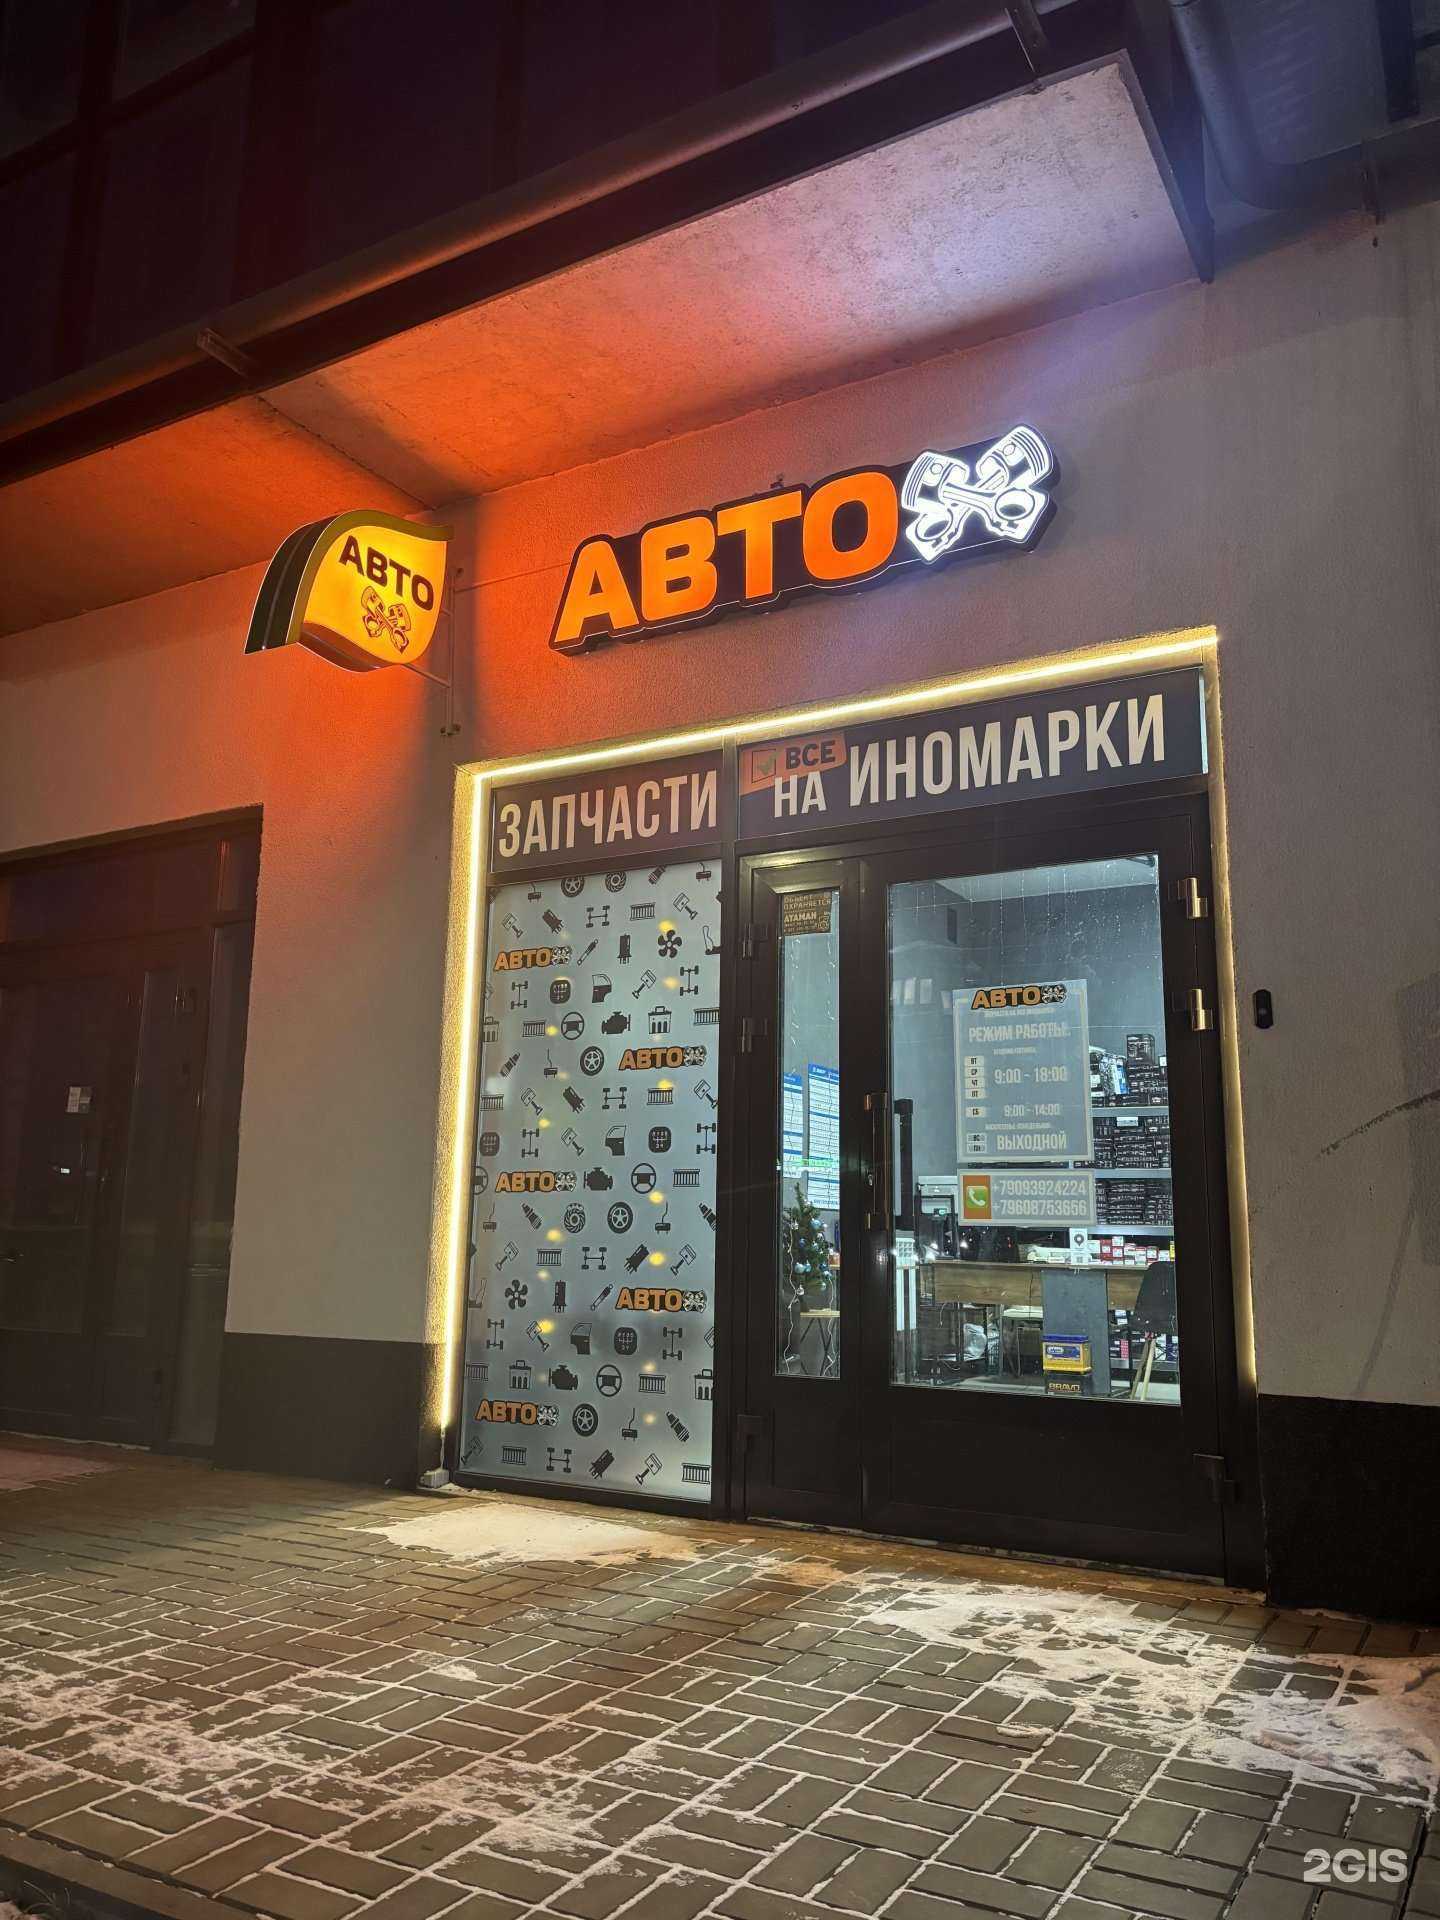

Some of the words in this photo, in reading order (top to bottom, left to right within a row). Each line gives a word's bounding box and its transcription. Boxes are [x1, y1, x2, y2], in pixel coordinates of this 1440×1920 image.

[553, 470, 899, 643] АВТО
[338, 534, 435, 611] АВТО
[785, 739, 836, 770] ВСЕ
[498, 770, 719, 858] ЗАПЧАСТИ
[774, 770, 826, 818] НА
[849, 694, 1166, 807] ИНОМАРКИ
[493, 947, 551, 970] АВТО
[971, 985, 1041, 1010] АВТО
[968, 1025, 1012, 1042] РЕЖИМ
[618, 1046, 684, 1070] АВТО
[994, 1068, 1021, 1085] 9:00
[1034, 1065, 1068, 1083] 18:00
[1003, 1104, 1025, 1117] 9:00
[1034, 1103, 1061, 1117] 14:00
[996, 1130, 1068, 1152] ВЫХОДНОЙ
[495, 1171, 555, 1192] АВТО
[615, 1287, 683, 1312] АВТО
[475, 1400, 538, 1426] АВТО
